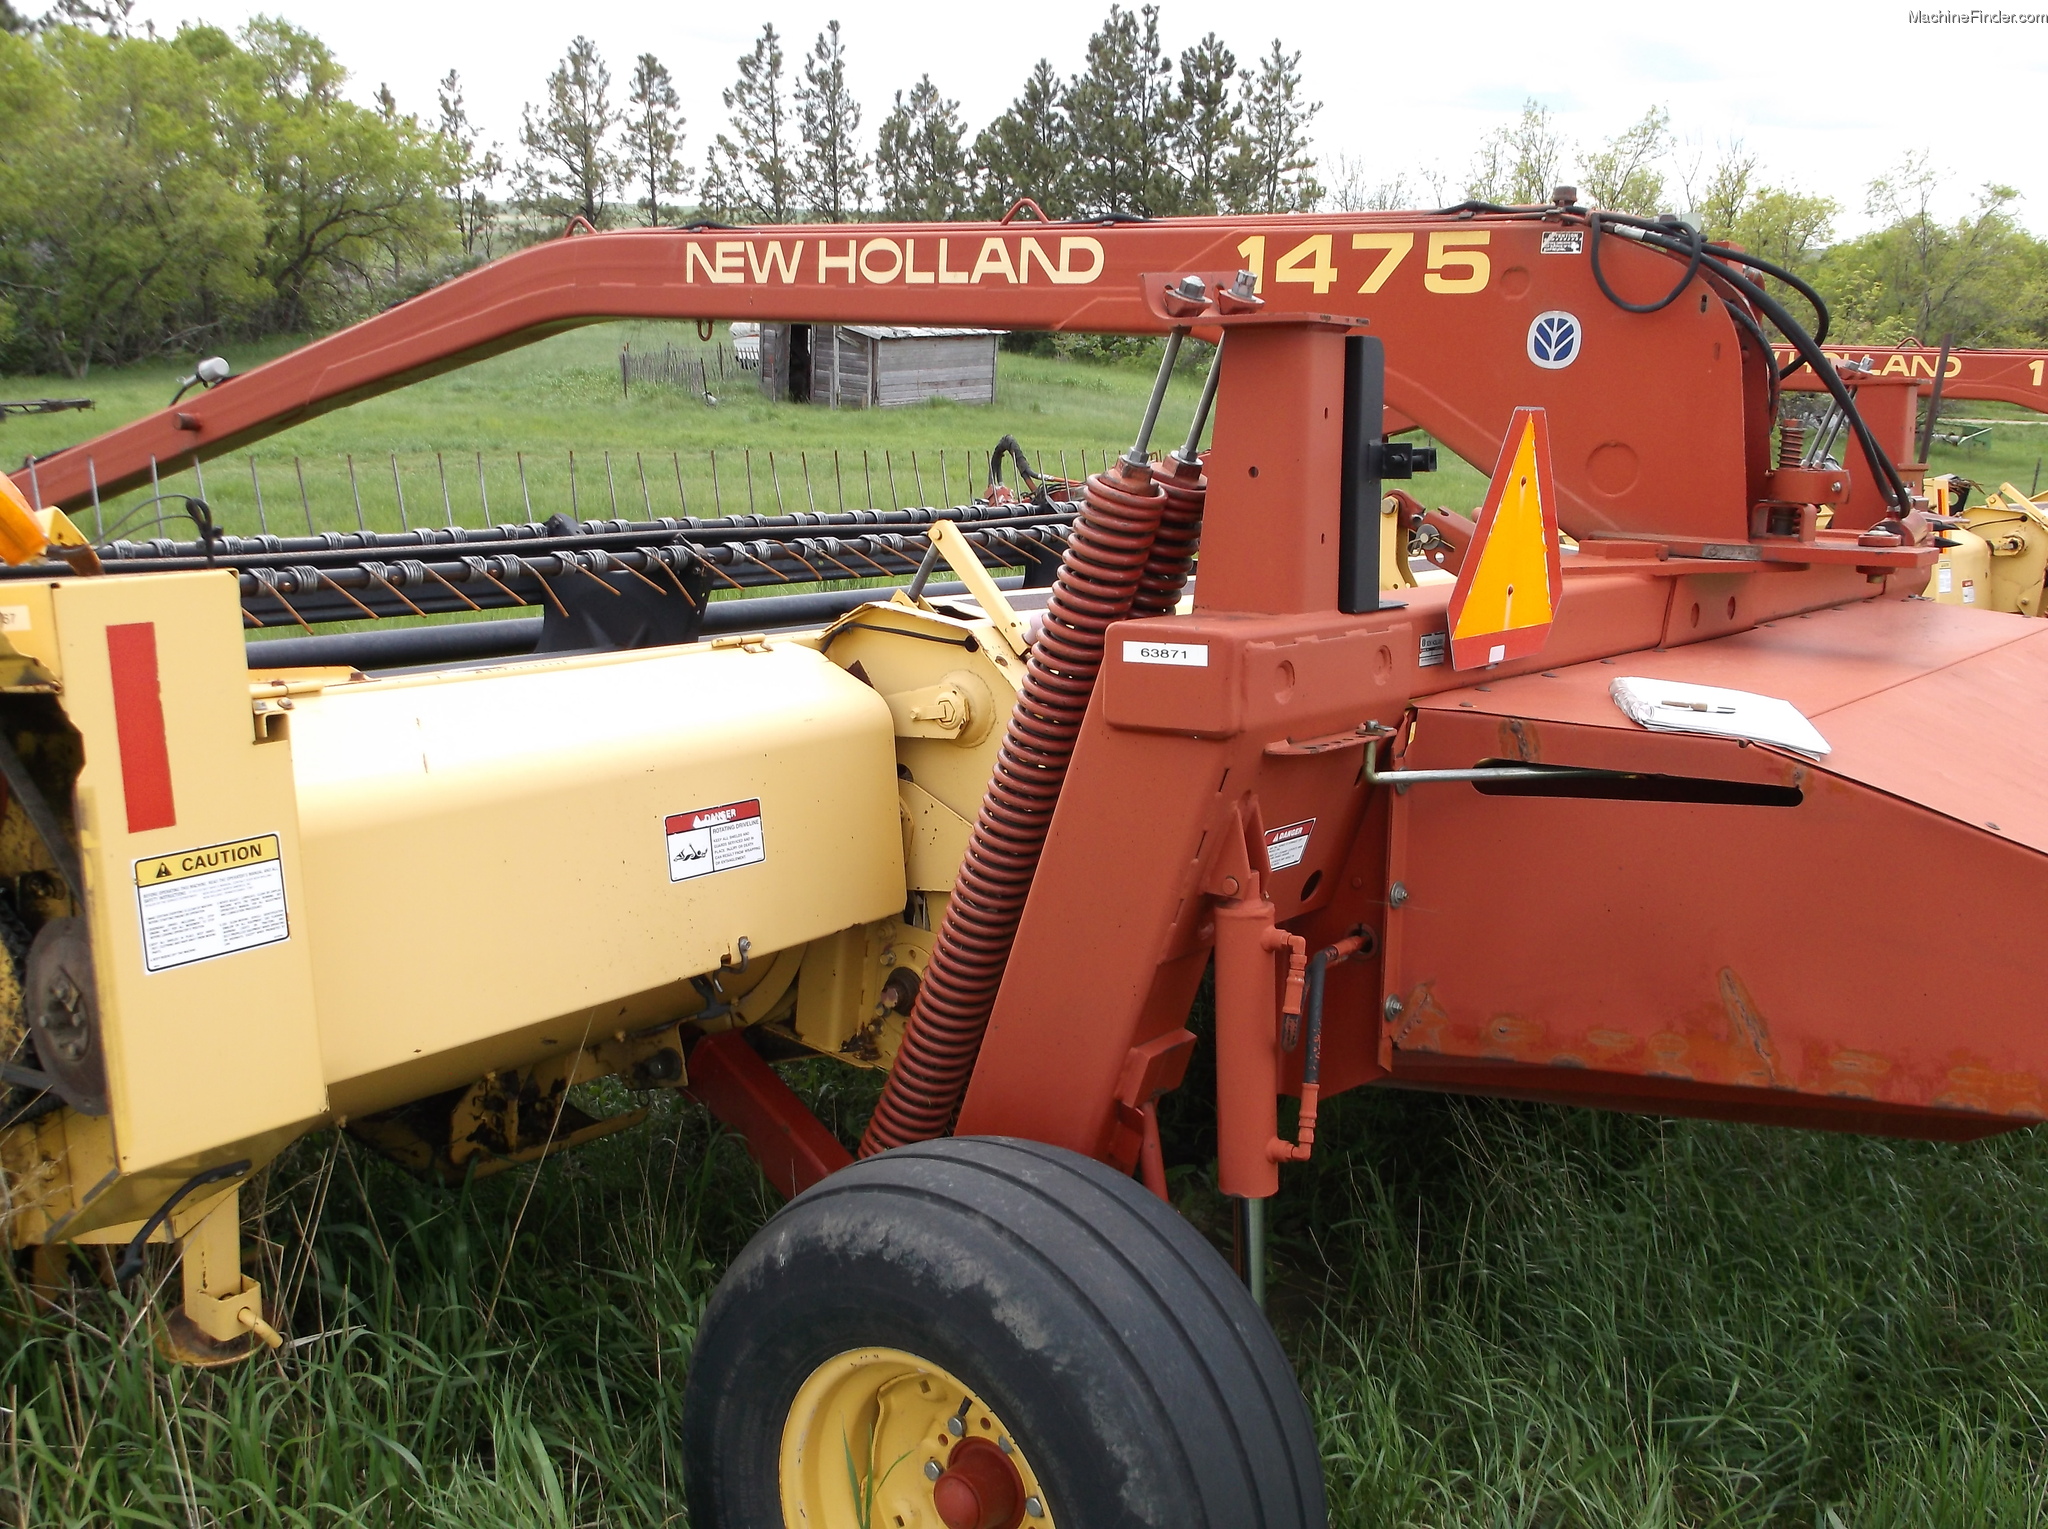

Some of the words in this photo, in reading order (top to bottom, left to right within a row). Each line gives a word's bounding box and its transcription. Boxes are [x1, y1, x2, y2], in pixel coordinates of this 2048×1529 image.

[686, 240, 804, 285] NEW
[818, 236, 1106, 286] HOLLAND
[1236, 230, 1492, 296] 1475
[1140, 647, 1187, 660] 63871
[712, 824, 735, 834] ROTATING
[736, 819, 759, 829] DRIVELINE
[1279, 827, 1304, 840] DANGER
[182, 843, 262, 872] CAUTION
